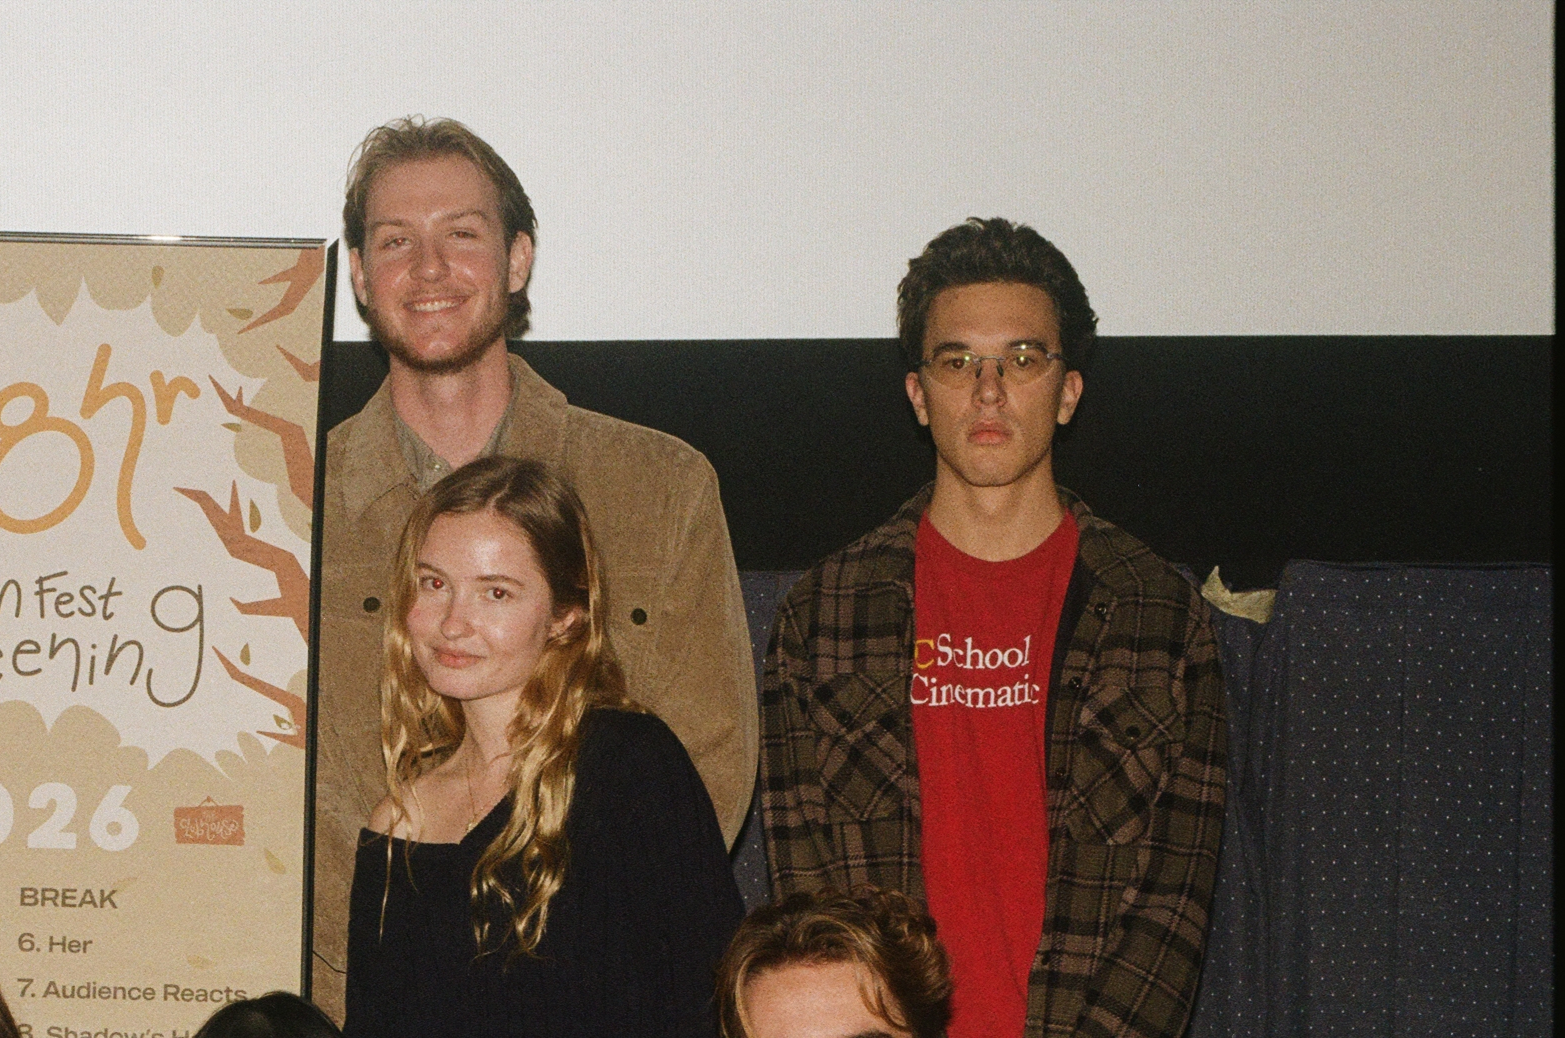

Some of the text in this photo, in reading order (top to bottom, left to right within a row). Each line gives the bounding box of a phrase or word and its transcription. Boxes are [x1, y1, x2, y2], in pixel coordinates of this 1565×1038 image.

[35, 571, 123, 620] Fest
[910, 673, 1040, 708] Cinematic
[20, 887, 118, 909] BREAK
[18, 932, 93, 953] 6. Her
[17, 978, 248, 1003] 7. Audience Reacts
